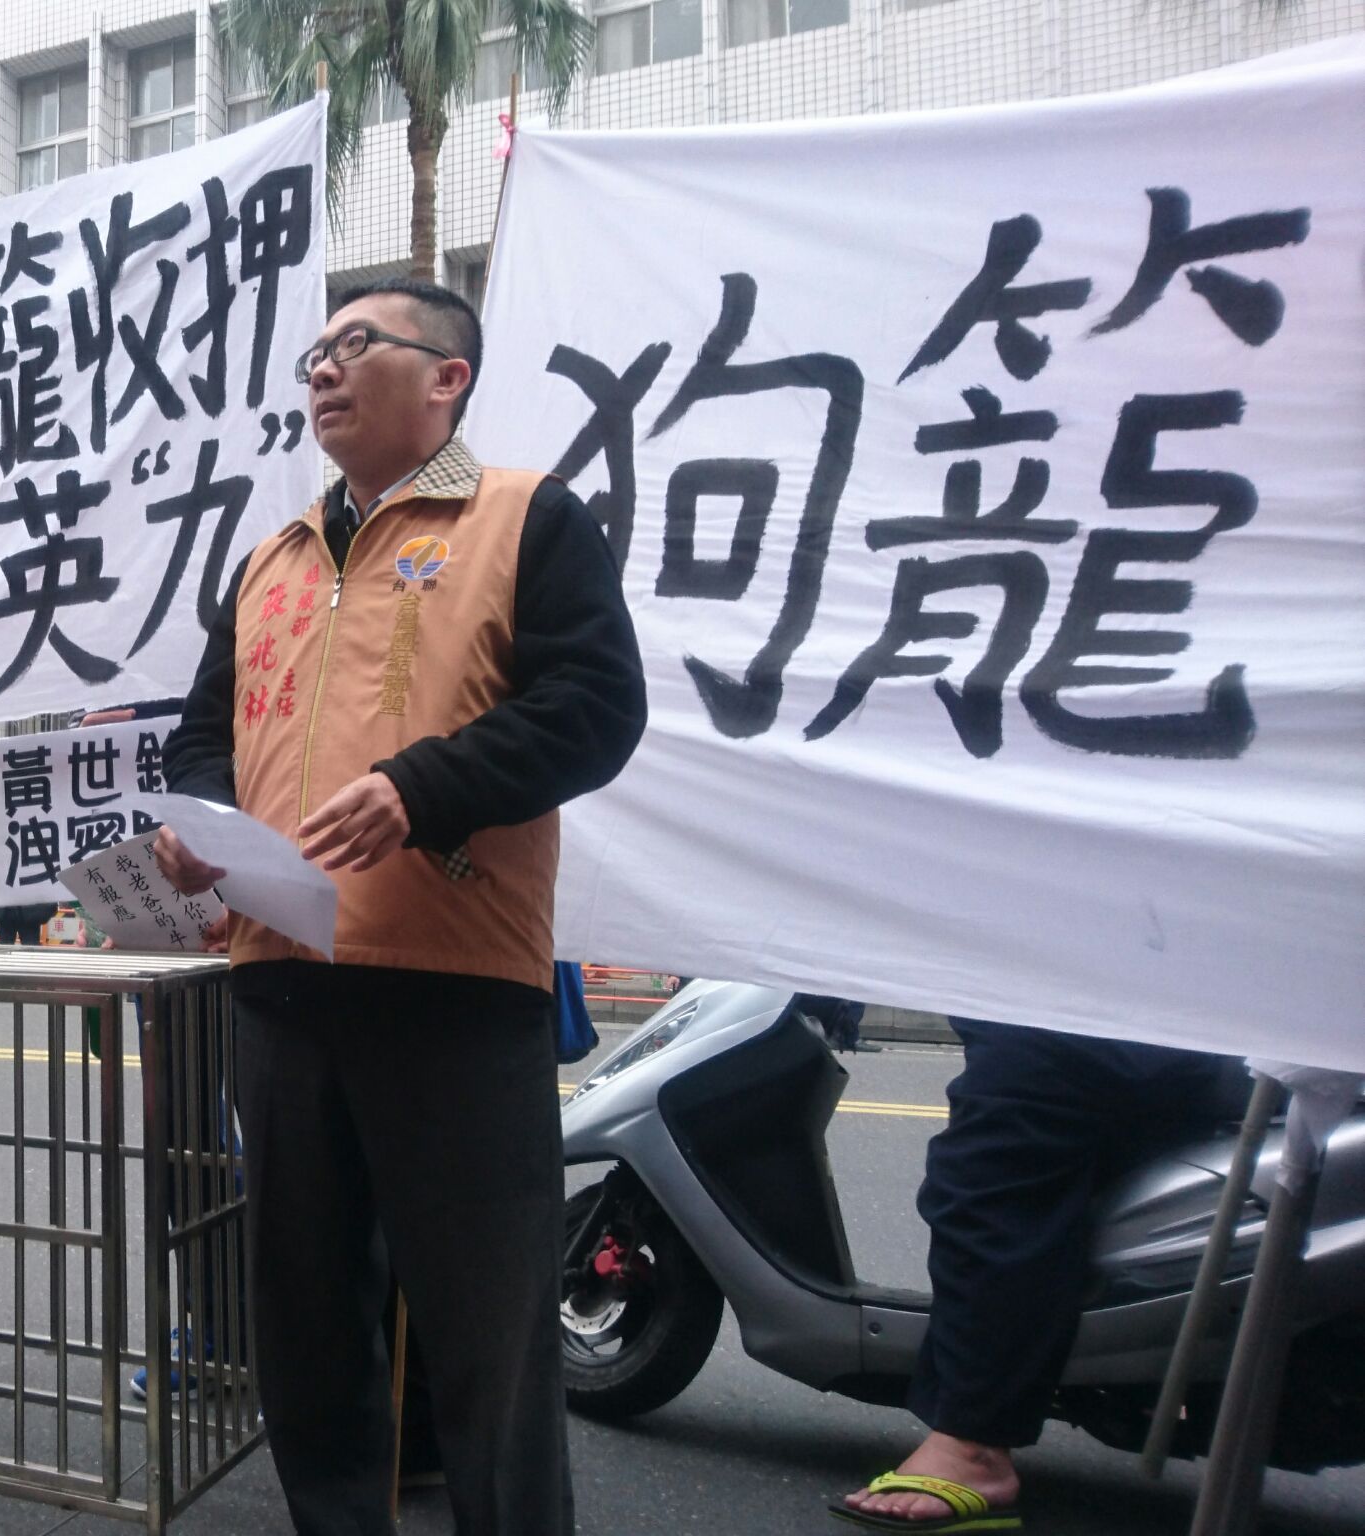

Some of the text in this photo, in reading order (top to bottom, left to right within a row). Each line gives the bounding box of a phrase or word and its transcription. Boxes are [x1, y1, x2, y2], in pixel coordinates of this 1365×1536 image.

[546, 186, 1311, 758] 狗籠
[243, 580, 289, 731] 張兆林
[5, 810, 164, 887] 洩密
[85, 866, 135, 923] 有報應
[116, 854, 187, 949] 我老爸的牛
